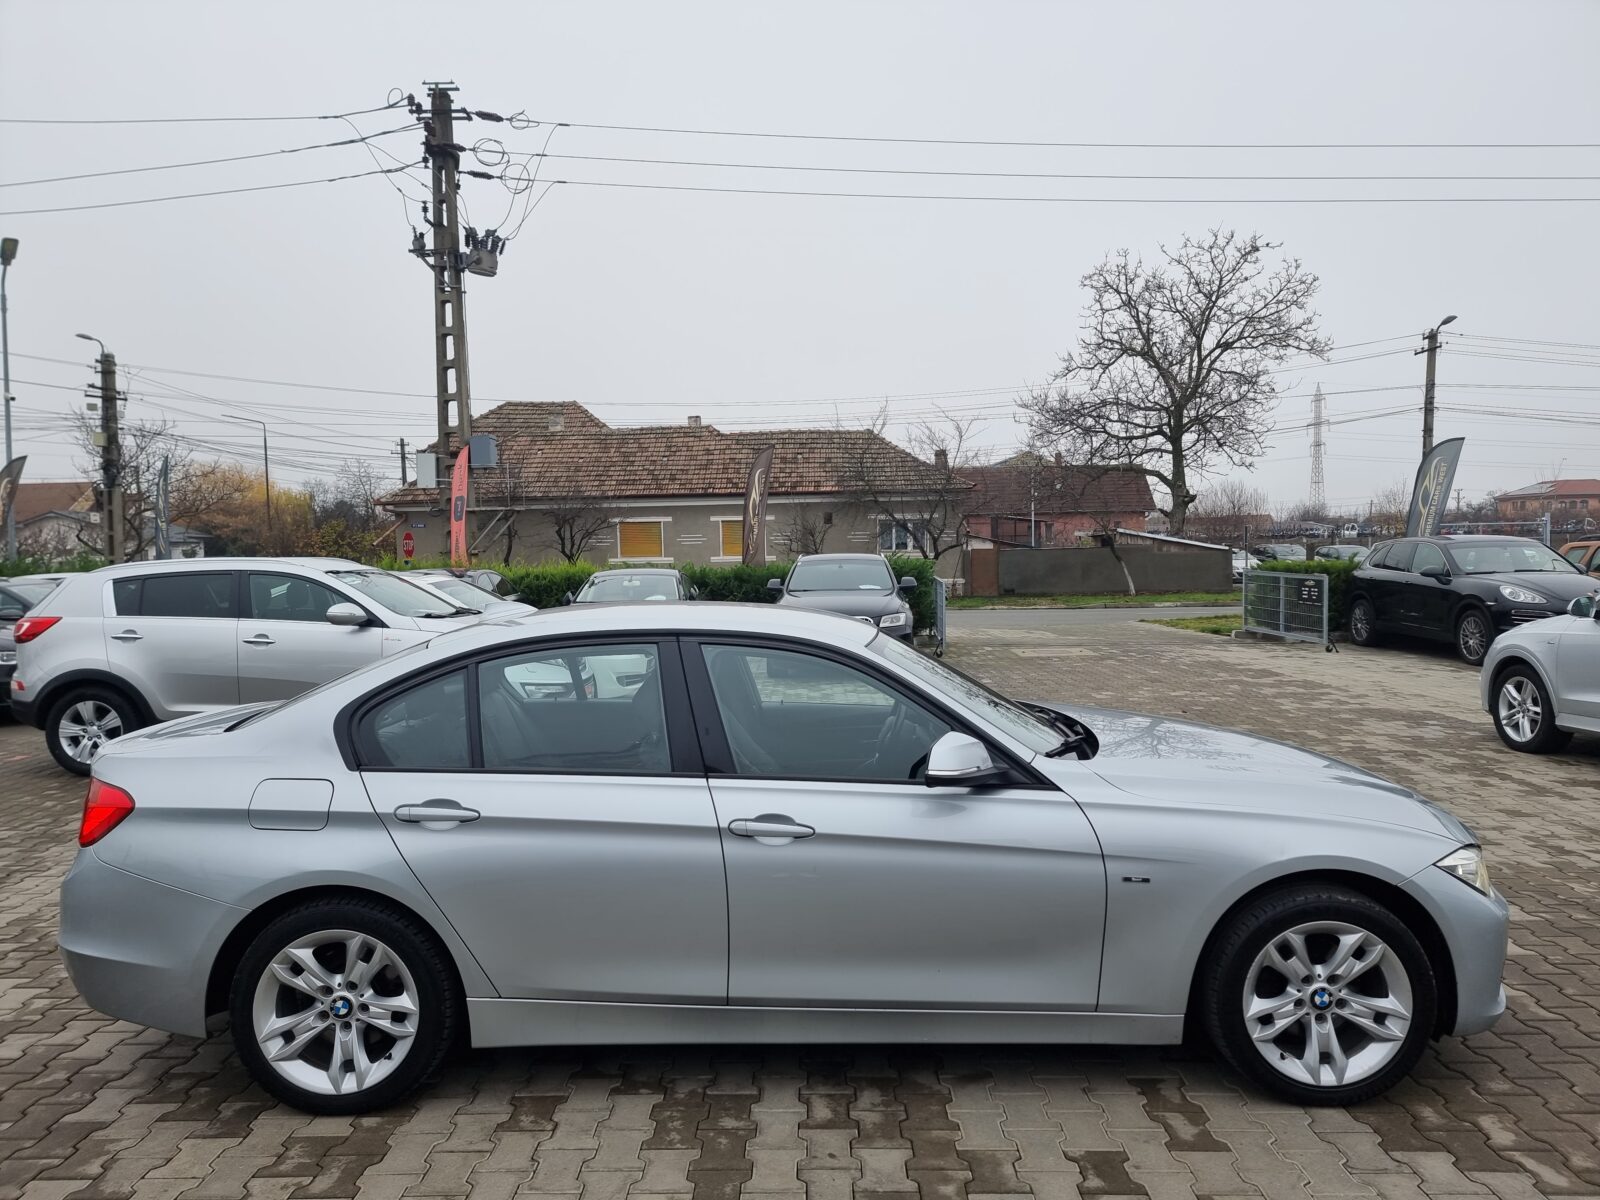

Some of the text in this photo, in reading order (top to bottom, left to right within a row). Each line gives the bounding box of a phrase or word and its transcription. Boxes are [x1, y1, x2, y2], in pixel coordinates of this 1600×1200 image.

[1424, 462, 1448, 537] PREMIUM CARS WEST
[403, 539, 414, 551] STOP
